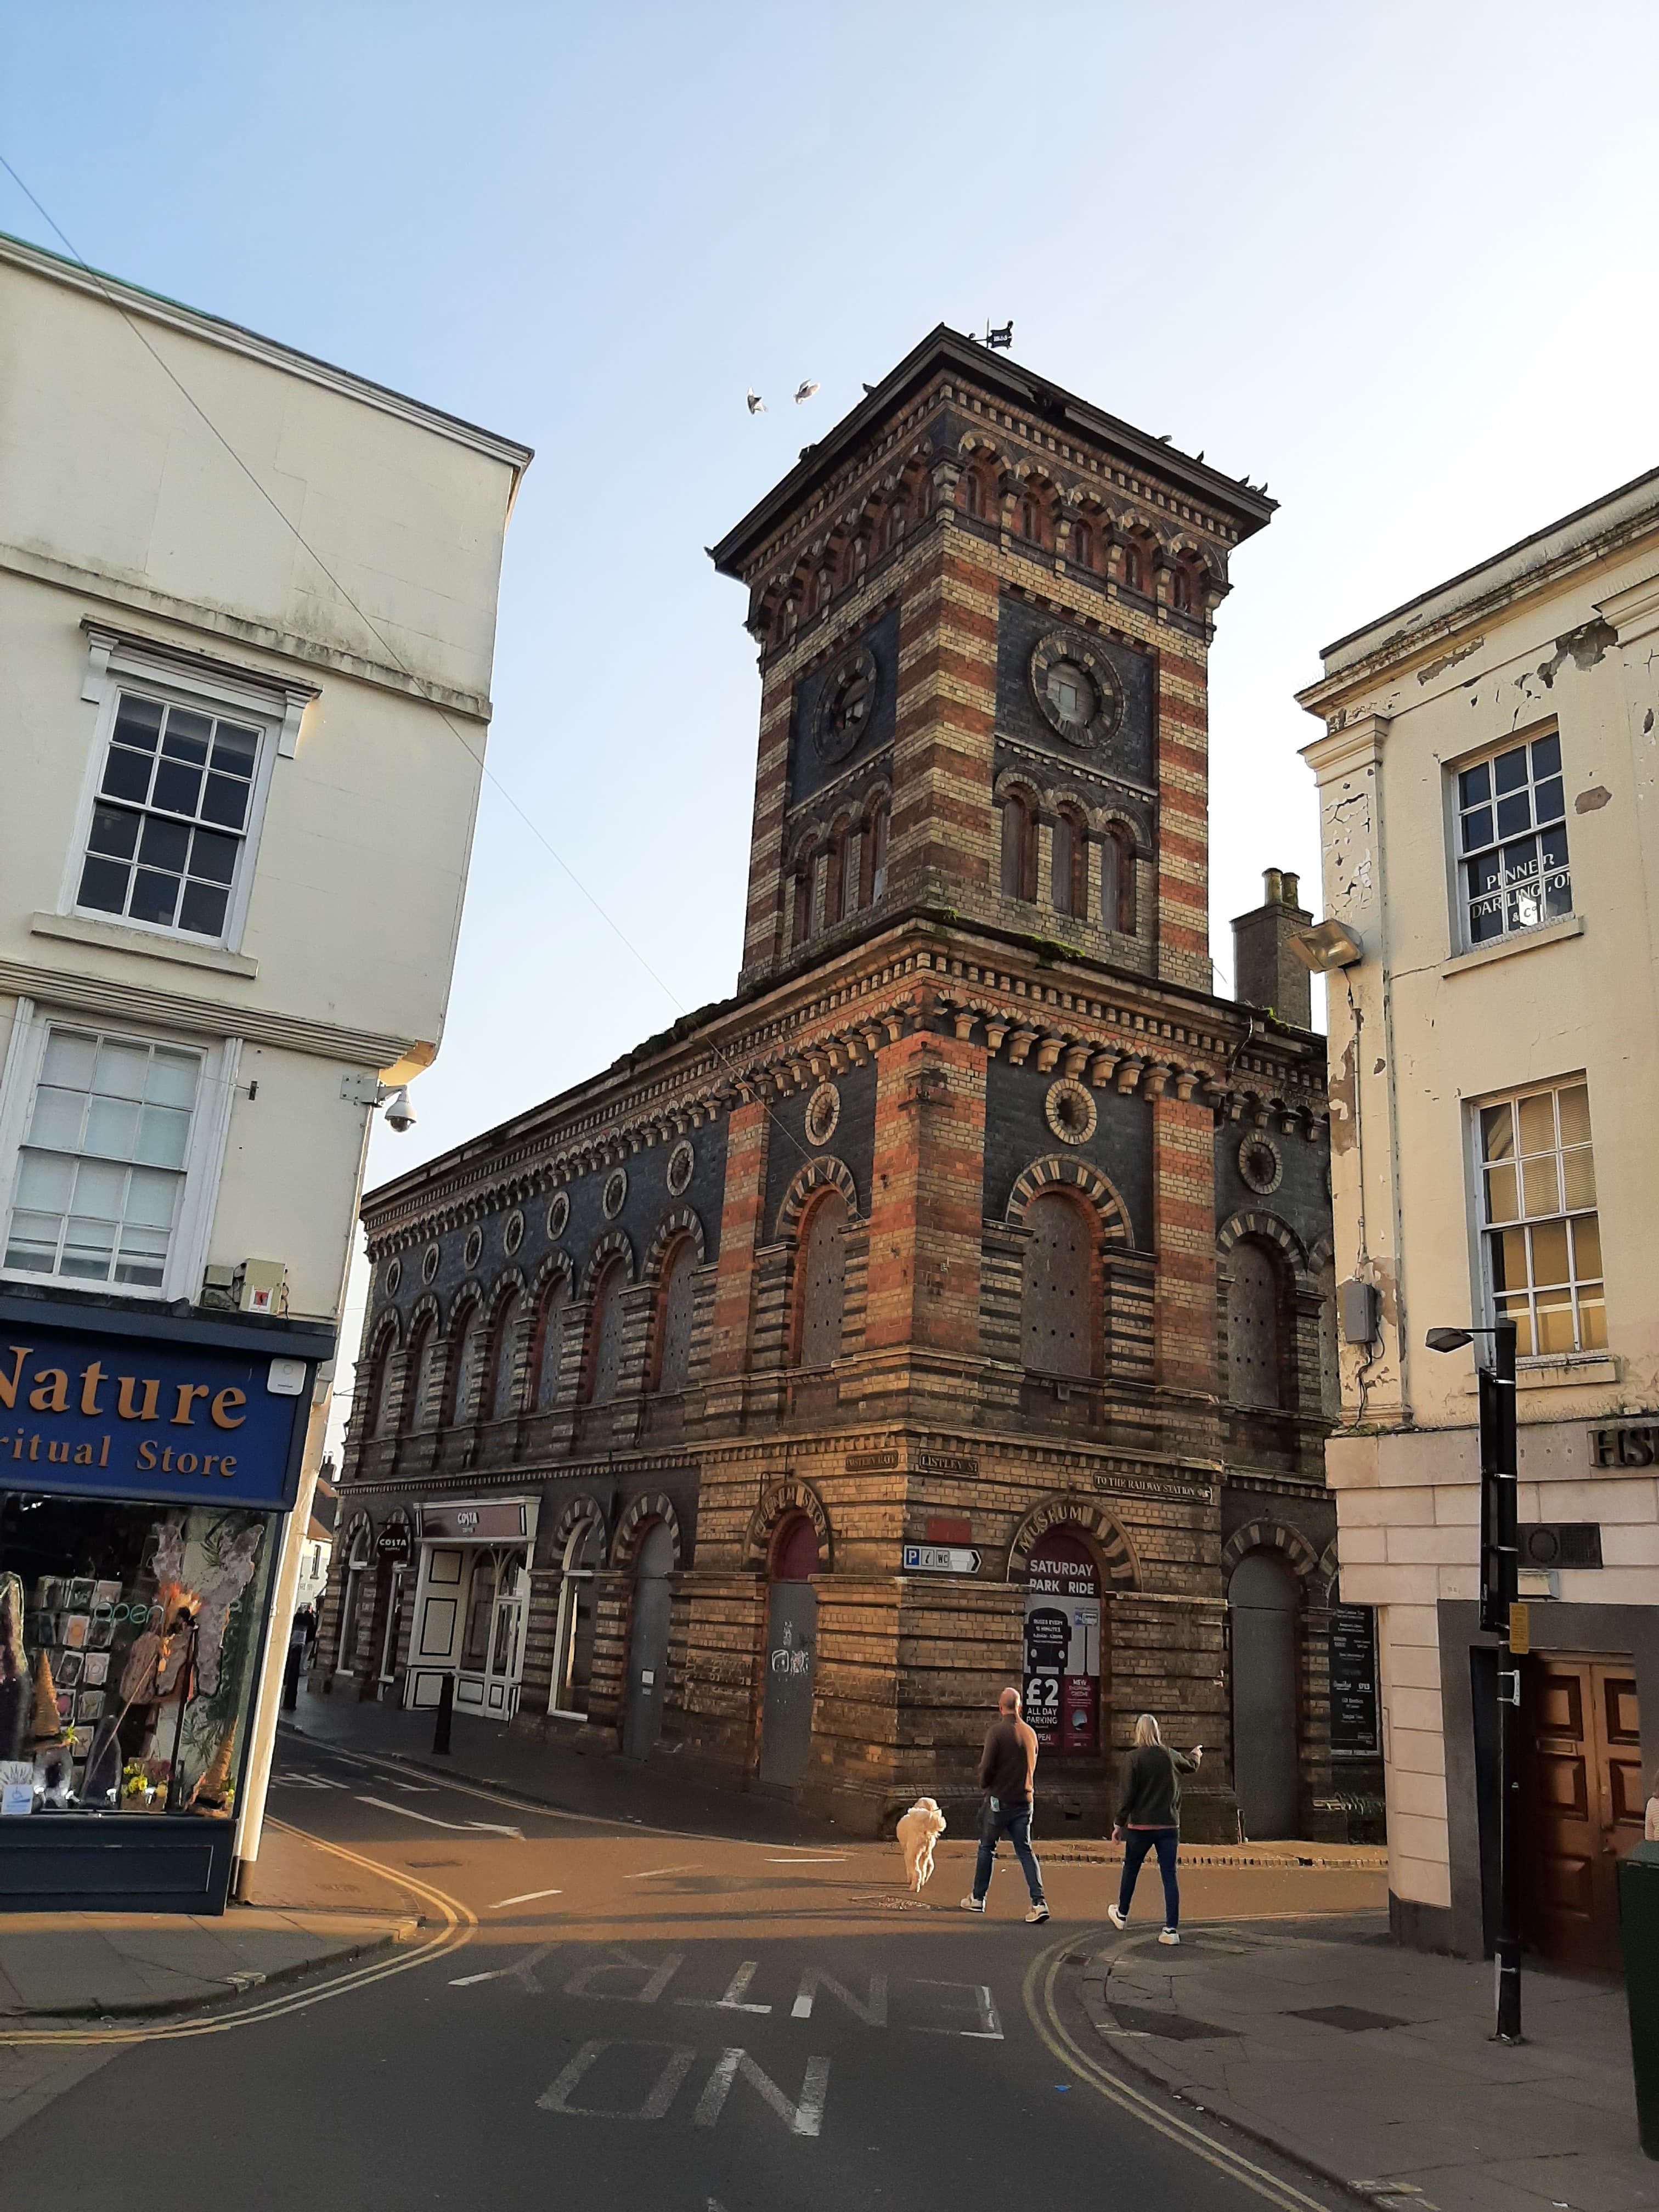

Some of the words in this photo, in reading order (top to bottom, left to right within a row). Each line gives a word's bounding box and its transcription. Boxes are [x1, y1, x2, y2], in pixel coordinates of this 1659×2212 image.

[1487, 854, 1555, 890] PINNER
[1512, 912, 1520, 922] &
[136, 1440, 238, 1477] Store
[922, 1456, 962, 1470] LISTLEY
[967, 1461, 977, 1472] ST
[1097, 1476, 1107, 1485] TO
[1109, 1477, 1126, 1488] THE
[1128, 1480, 1161, 1492] RAILWAY
[1163, 1484, 1195, 1496] STATION
[457, 1512, 478, 1527] COSTA
[1018, 1505, 1082, 1553] MUSEUM
[379, 1538, 407, 1547] COSTA
[908, 1550, 917, 1564] P
[938, 1554, 949, 1564] WC
[1030, 1560, 1093, 1576] SATURDAY
[1029, 1578, 1060, 1593] PARK
[1068, 1581, 1095, 1595] RIDE
[94, 1602, 165, 1624] open
[1026, 1678, 1059, 1706] £2
[1027, 1707, 1041, 1715] ALL
[1042, 1707, 1058, 1716] DAY
[1026, 1716, 1058, 1725] PARKING
[1037, 1733, 1052, 1742] PEN
[535, 2039, 832, 2136] NO
